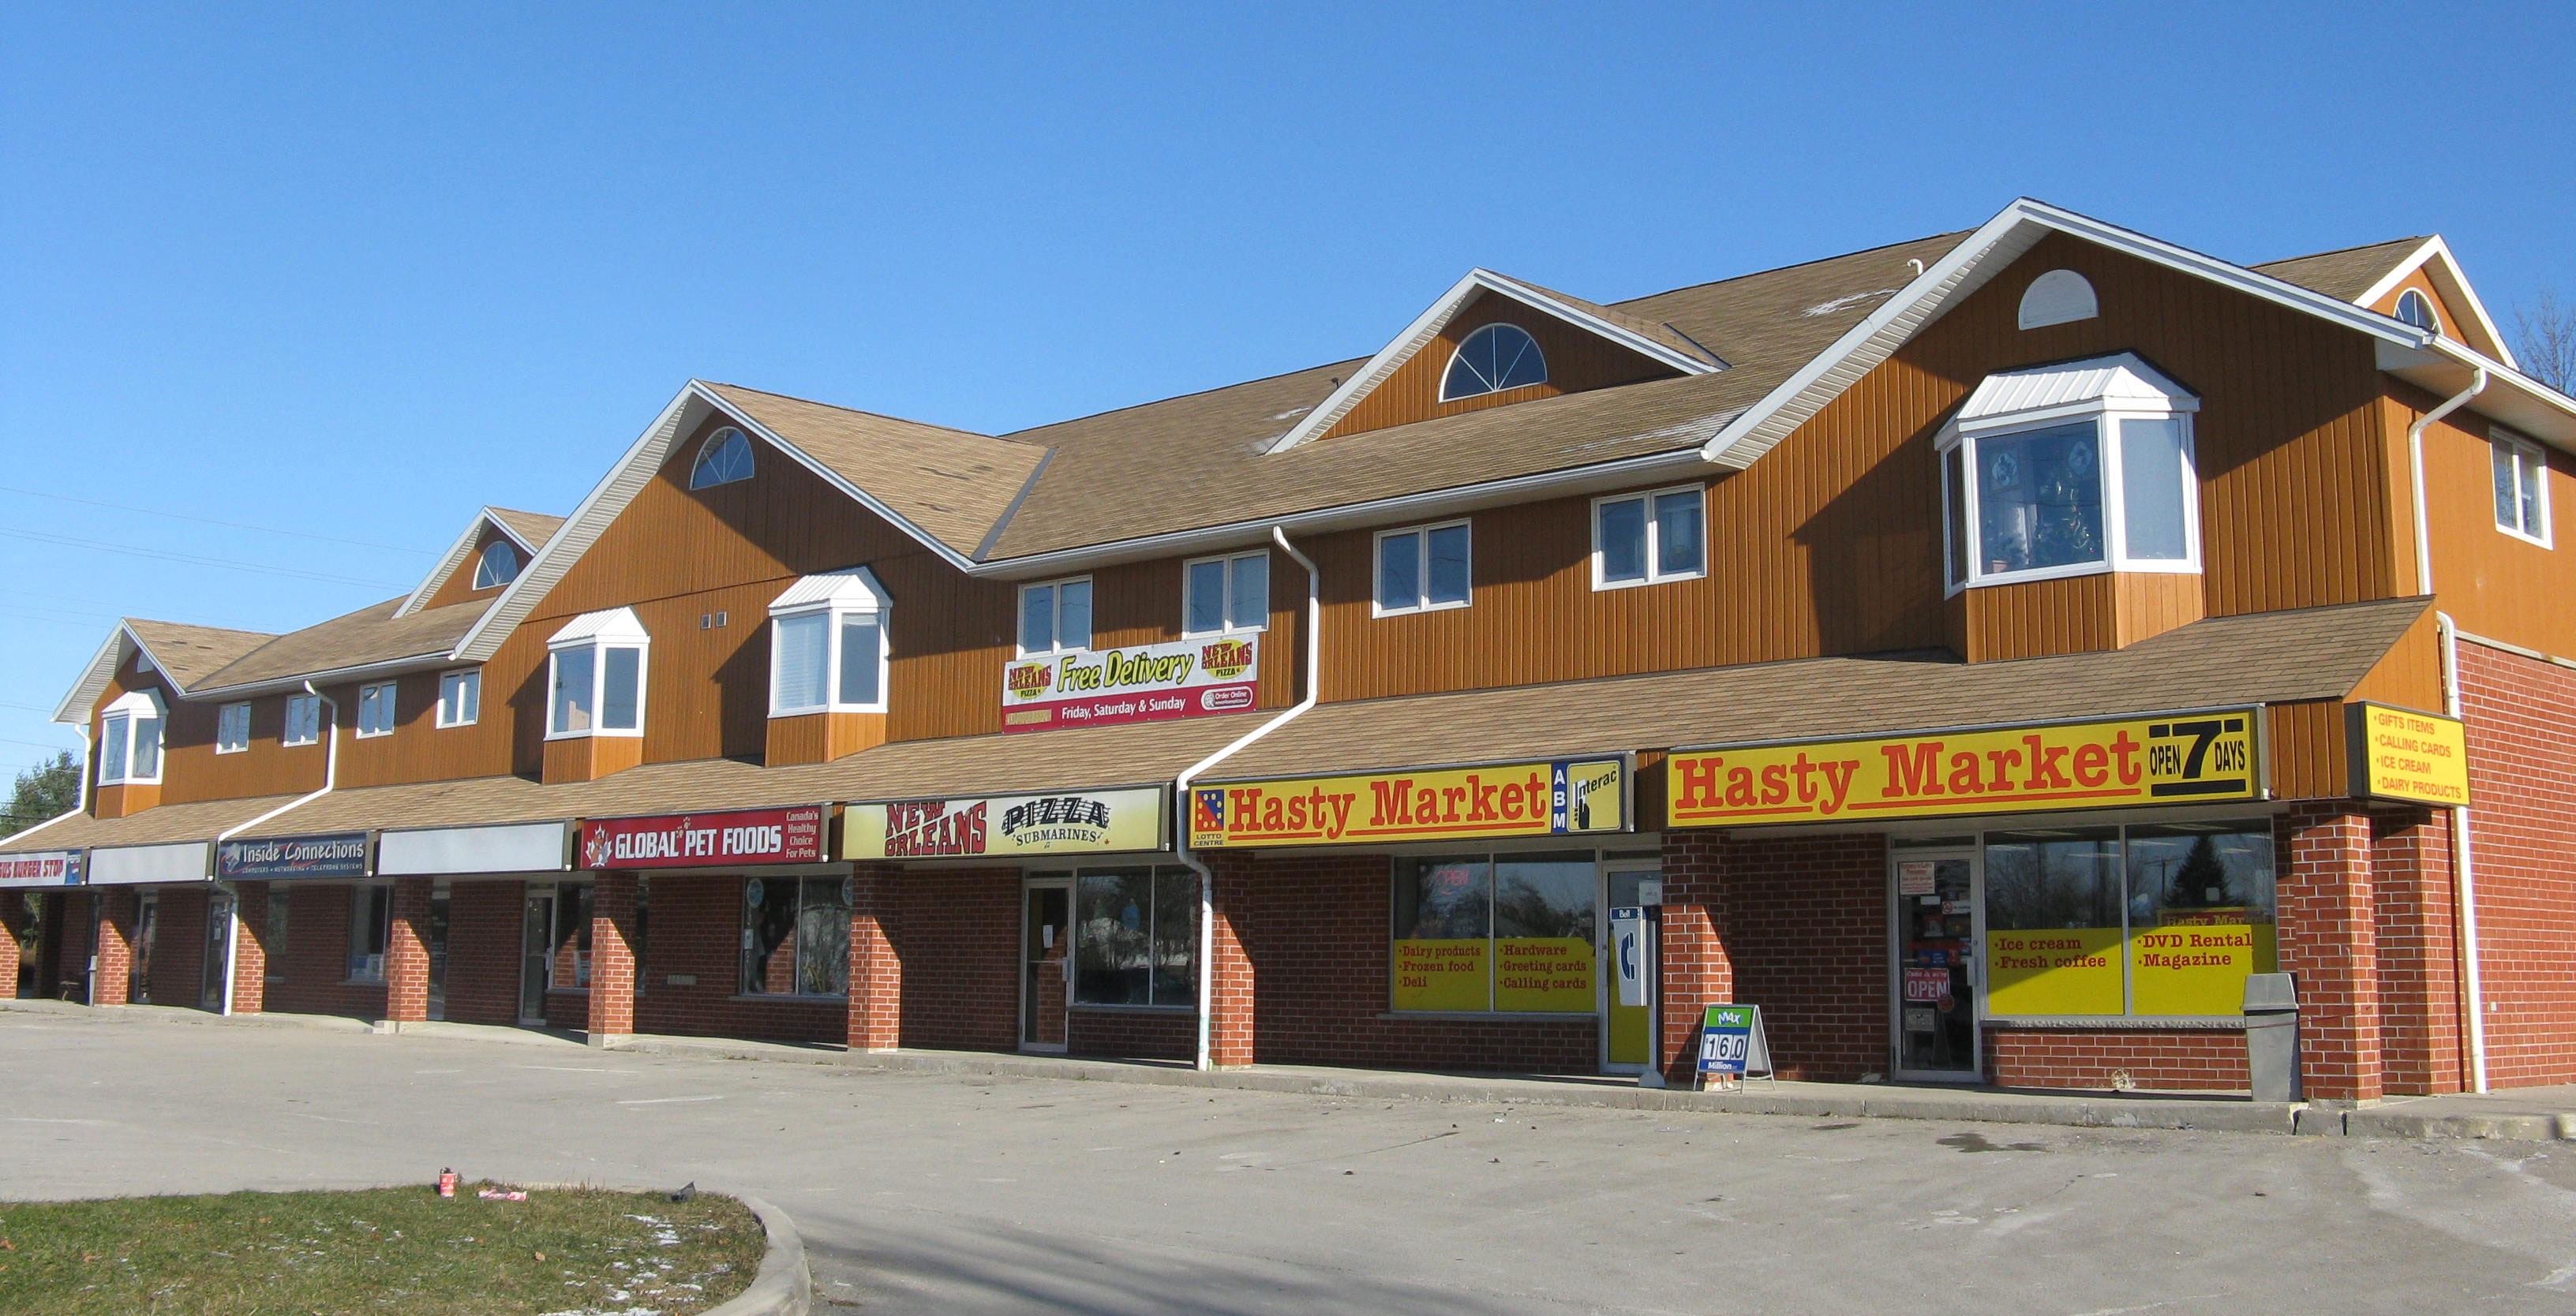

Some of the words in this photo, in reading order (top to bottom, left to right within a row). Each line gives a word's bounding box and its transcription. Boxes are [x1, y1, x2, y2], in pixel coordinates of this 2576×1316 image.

[1202, 642, 1232, 664] NEW
[1202, 641, 1253, 669] ORLEANS
[1009, 664, 1052, 690] ORLEANS
[1058, 656, 1101, 693] Free
[1103, 650, 1195, 688] Delivery
[1216, 667, 1236, 677] PIZZA
[1020, 689, 1037, 697] PIZZA
[1061, 706, 1092, 720] Friday,
[1094, 701, 1136, 720] Saturday
[1139, 700, 1147, 712] &
[1149, 697, 1186, 715] Sunday
[2378, 713, 2405, 729] GIFTS
[2407, 719, 2435, 735] ITEMS
[2149, 746, 2181, 777] OPEN
[2173, 721, 2221, 780] 7
[2215, 740, 2246, 772] DAYS
[2379, 734, 2419, 753] CALLING
[2421, 742, 2451, 758] CARDS
[1674, 752, 1860, 815] Hasty
[1881, 731, 2142, 798] Market
[2380, 755, 2396, 769] ICE
[2398, 758, 2432, 775] CREAM
[1572, 770, 1617, 808] Interac
[2382, 776, 2410, 792] DAIRY
[2413, 781, 2462, 799] PRODUCTS
[1228, 786, 1356, 839] Hasty
[1368, 772, 1547, 826] Market
[786, 810, 819, 821] Canada's
[886, 801, 947, 838] NEW
[1002, 797, 1110, 836] PIZZA
[788, 823, 817, 835] Healthy
[885, 800, 987, 857] ORLEANS
[1016, 828, 1097, 847] SUBMARINES
[614, 831, 680, 860] GLOBAL
[683, 828, 717, 857] PET
[721, 824, 783, 855] FOODS
[789, 836, 813, 846] Choice
[243, 841, 280, 863] Inside
[285, 839, 365, 861] Connections
[786, 848, 798, 858] For
[799, 847, 816, 858] Pets
[43, 859, 64, 877] STOP
[1619, 909, 1631, 918] Bell
[1999, 939, 2025, 951] Ice
[2029, 939, 2082, 951] cream
[2142, 934, 2183, 948] DVD
[2189, 933, 2252, 948] Rental
[1402, 946, 1431, 959] Dairy
[1435, 946, 1481, 959] products
[1504, 944, 1567, 956] Hardware
[1402, 960, 1443, 973] Frozen
[1448, 960, 1475, 972] food
[1503, 960, 1552, 976] Greeting
[1556, 959, 1587, 972] cards
[1999, 956, 2048, 969] Fresh
[2054, 955, 2106, 968] coffee
[2142, 952, 2232, 970] Magazine
[1402, 976, 1428, 988] Deli
[1503, 977, 1549, 993] Calling
[1553, 976, 1587, 989] cards
[1907, 981, 1948, 998] OPEN
[1718, 1011, 1741, 1025] MAX
